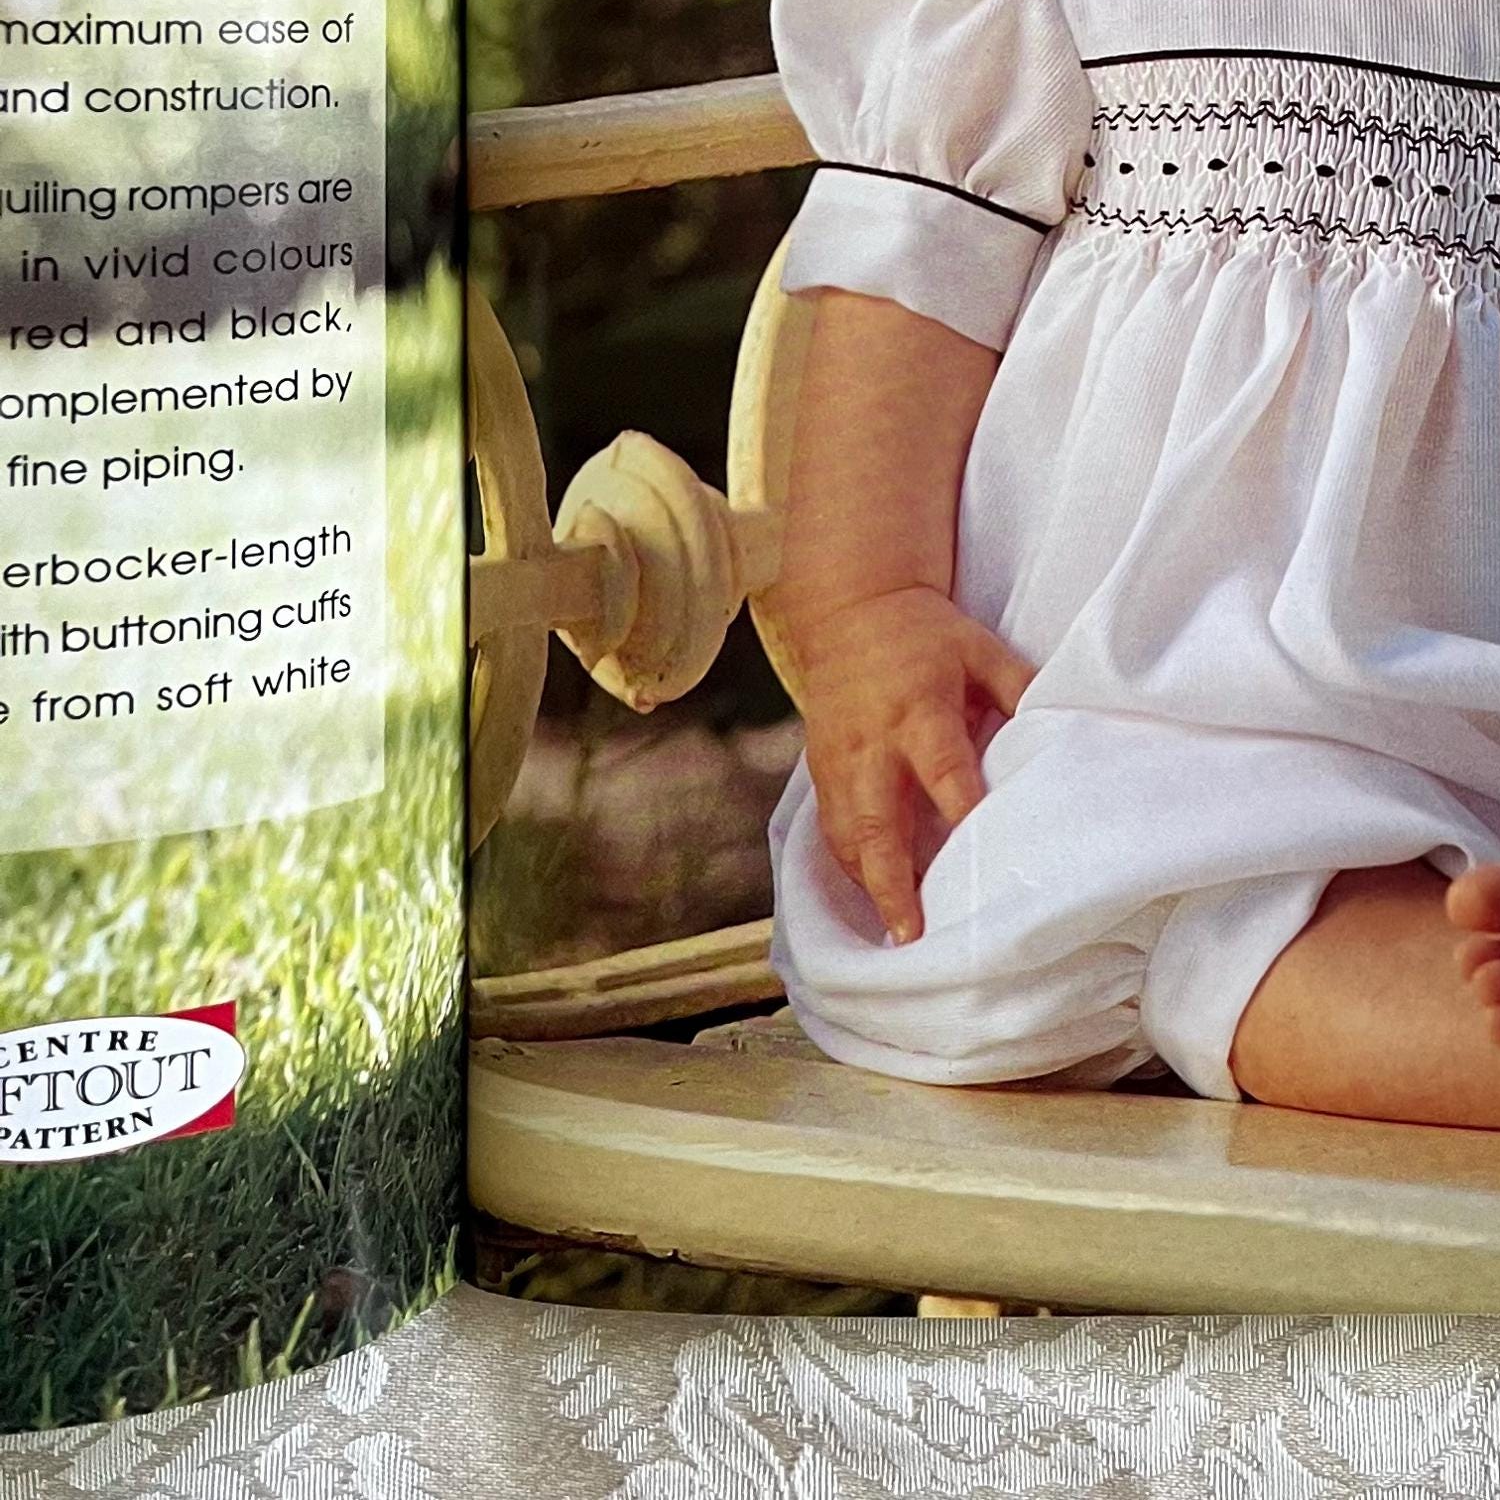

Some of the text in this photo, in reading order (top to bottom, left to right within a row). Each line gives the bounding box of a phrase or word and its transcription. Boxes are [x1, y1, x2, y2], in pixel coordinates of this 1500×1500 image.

[219, 20, 309, 44] ease
[322, 13, 354, 43] of
[0, 75, 338, 113] nd construction.
[0, 178, 352, 220] uiling rompers are
[22, 241, 353, 282] in vivid colours
[10, 301, 353, 350] red and black,
[0, 368, 352, 424] omplemented by
[6, 446, 243, 490] fine piping.
[3, 524, 351, 588] erbocker-length
[0, 588, 352, 657] ith buttoning cuffs
[32, 690, 134, 722] from
[156, 671, 233, 711] soft
[252, 656, 350, 697] white
